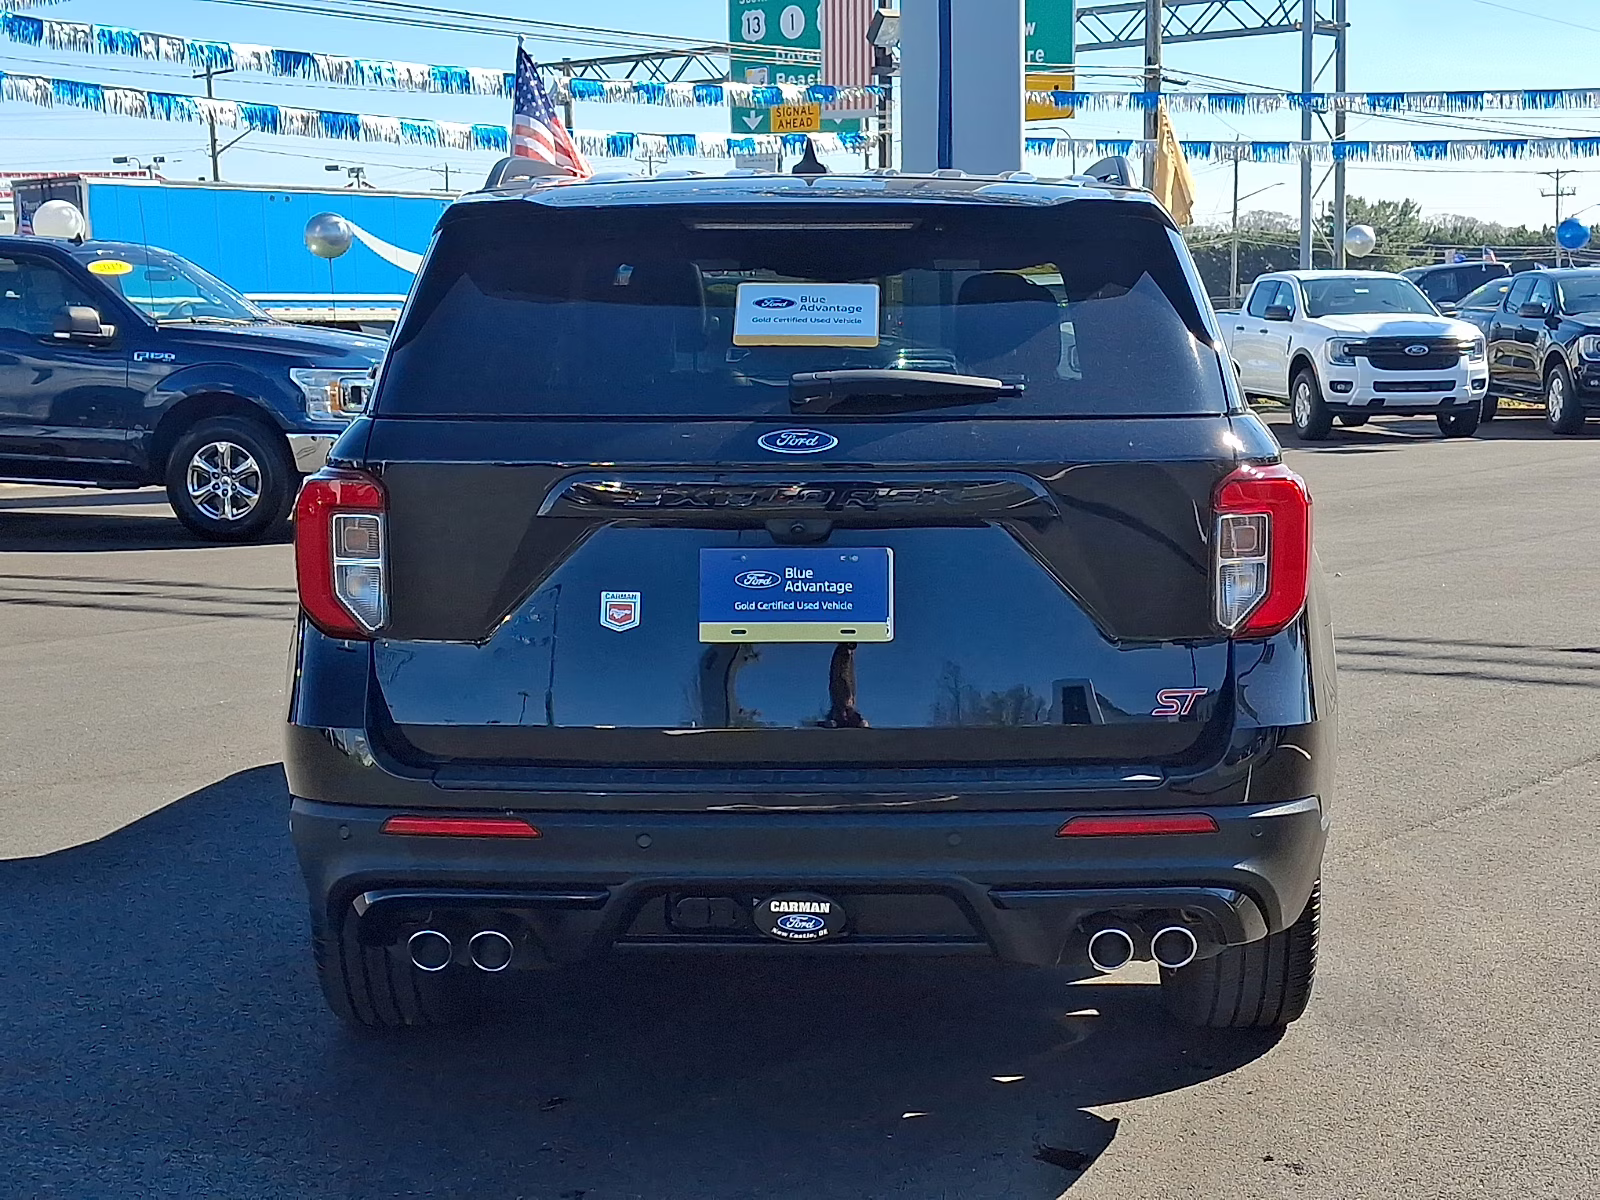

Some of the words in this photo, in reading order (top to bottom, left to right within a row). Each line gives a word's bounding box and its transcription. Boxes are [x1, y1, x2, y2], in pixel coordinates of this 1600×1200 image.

[746, 16, 760, 34] 13
[790, 13, 795, 31] 1
[776, 106, 814, 117] SIGNAL
[777, 118, 813, 129] AHEAD
[799, 304, 862, 313] Advantage
[785, 567, 814, 579] Blue
[784, 581, 853, 594] Advantage
[734, 601, 755, 610] Gold
[757, 601, 795, 610] Certified
[797, 601, 820, 610] Used
[821, 601, 853, 610] Vehicle
[1151, 687, 1208, 715] ST
[770, 901, 830, 913] CARMAN
[771, 927, 788, 937] New
